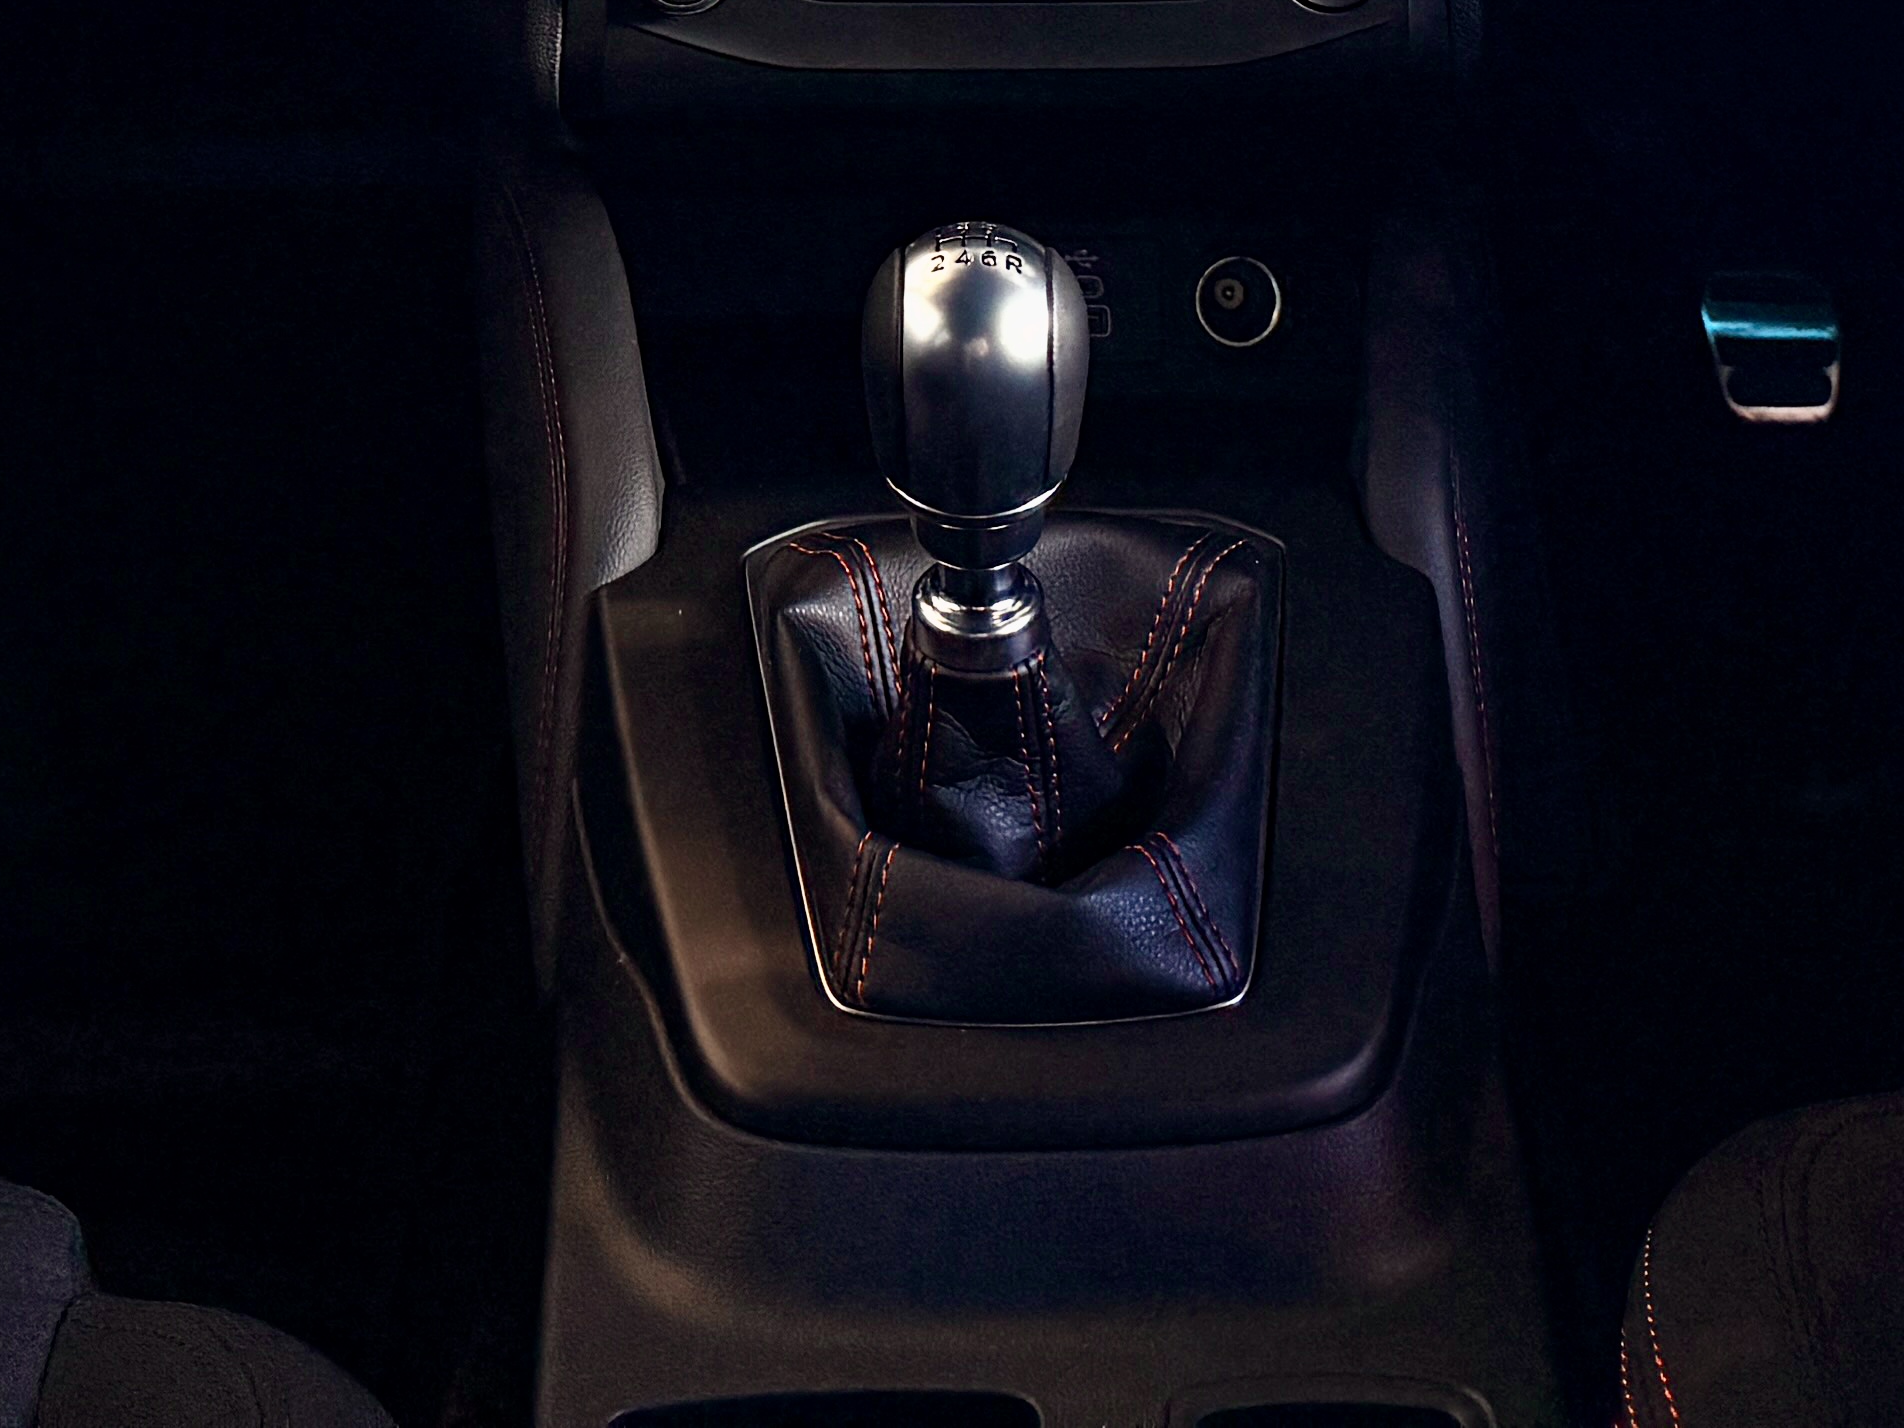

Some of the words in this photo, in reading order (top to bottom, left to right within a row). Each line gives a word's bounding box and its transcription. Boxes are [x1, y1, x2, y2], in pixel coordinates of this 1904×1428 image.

[930, 254, 945, 273] 2
[954, 249, 972, 266] 4
[981, 249, 997, 267] 6
[1005, 254, 1023, 274] R
